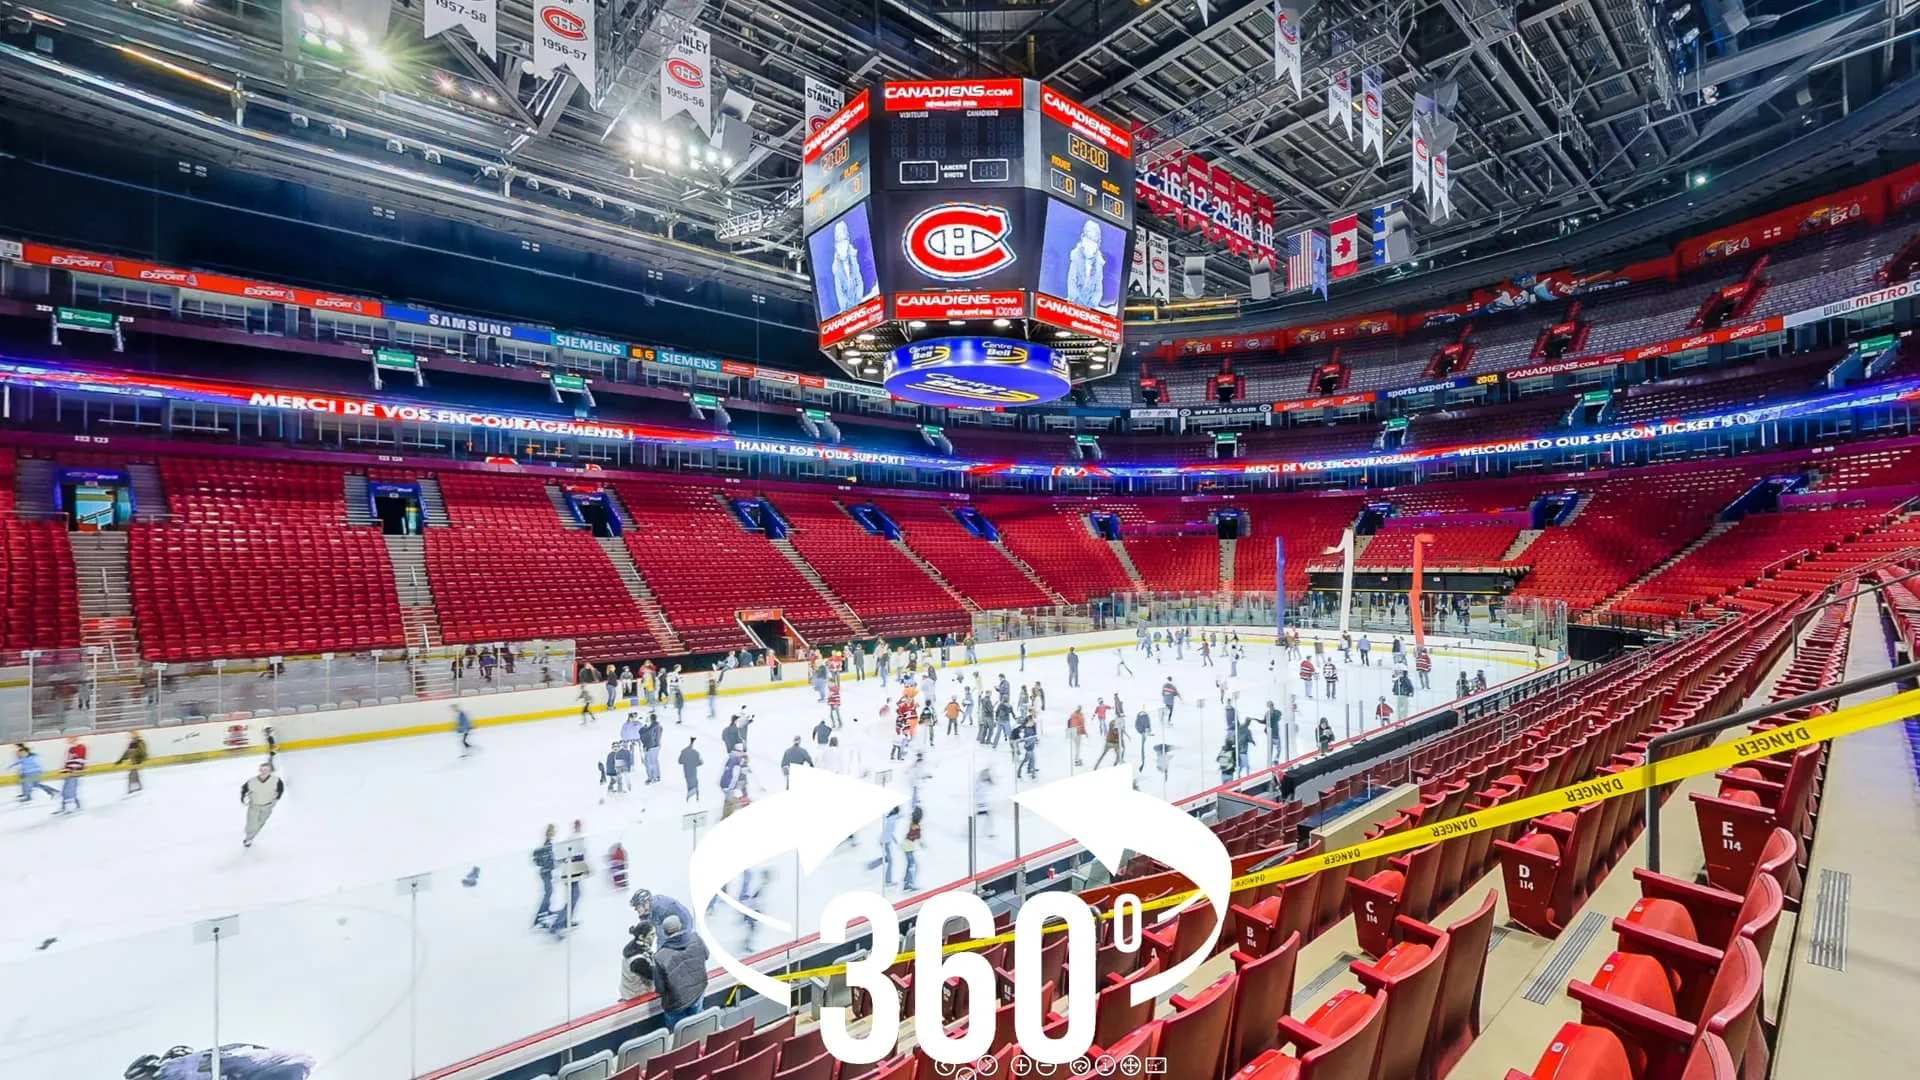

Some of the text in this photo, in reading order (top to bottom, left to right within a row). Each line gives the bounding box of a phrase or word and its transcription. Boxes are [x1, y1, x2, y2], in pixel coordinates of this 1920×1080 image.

[542, 37, 587, 61] 1956-57
[666, 86, 705, 108] 1955-56
[807, 87, 843, 110] STANLEY
[1071, 137, 1106, 170] 20:00
[51, 255, 103, 268] EXPORT
[140, 270, 188, 282] EXPORT
[244, 286, 289, 298] EXPORT
[315, 298, 354, 310] EXPORT
[897, 294, 1017, 306] CANADIENS.COM
[428, 313, 512, 337] SAMSUNG
[1730, 325, 1759, 339] EXPORT
[556, 335, 622, 355] SIEMENS
[981, 341, 1012, 350] Centre
[913, 351, 933, 359] Bell
[986, 349, 1011, 357] Bell
[661, 352, 718, 370] SIEMENS
[1506, 360, 1600, 380] CANADIENS.COM
[1387, 381, 1456, 398] sports experts
[249, 392, 336, 413] MERCI
[343, 402, 375, 416] DE
[378, 406, 434, 422] VOS
[437, 410, 624, 438] ENCOURAGEMENTS
[1194, 406, 1257, 415] www.i4c.com
[1458, 441, 1529, 457] WELCOME
[1532, 438, 1552, 449] TO
[1555, 434, 1590, 447] OUR
[1593, 426, 1656, 444] SEASON
[1660, 417, 1715, 434] TICKET
[734, 440, 786, 455] THANKS
[789, 446, 814, 457] FOR
[817, 448, 851, 460] YOUR
[852, 453, 900, 465] SUPPORT
[1244, 464, 1280, 473] MERCI
[1282, 463, 1297, 471] DE
[1299, 461, 1325, 470] VOS
[1736, 727, 1811, 757] DANGER
[1565, 777, 1624, 803] DANGER
[1431, 817, 1478, 837] DANGER
[1721, 821, 1734, 837] E
[1723, 839, 1742, 851] 114
[1323, 848, 1361, 865] DANGER
[1519, 864, 1531, 879] D
[1519, 880, 1534, 891] 114
[1365, 901, 1375, 914] C
[1366, 915, 1378, 924] 114
[1246, 926, 1255, 938] B
